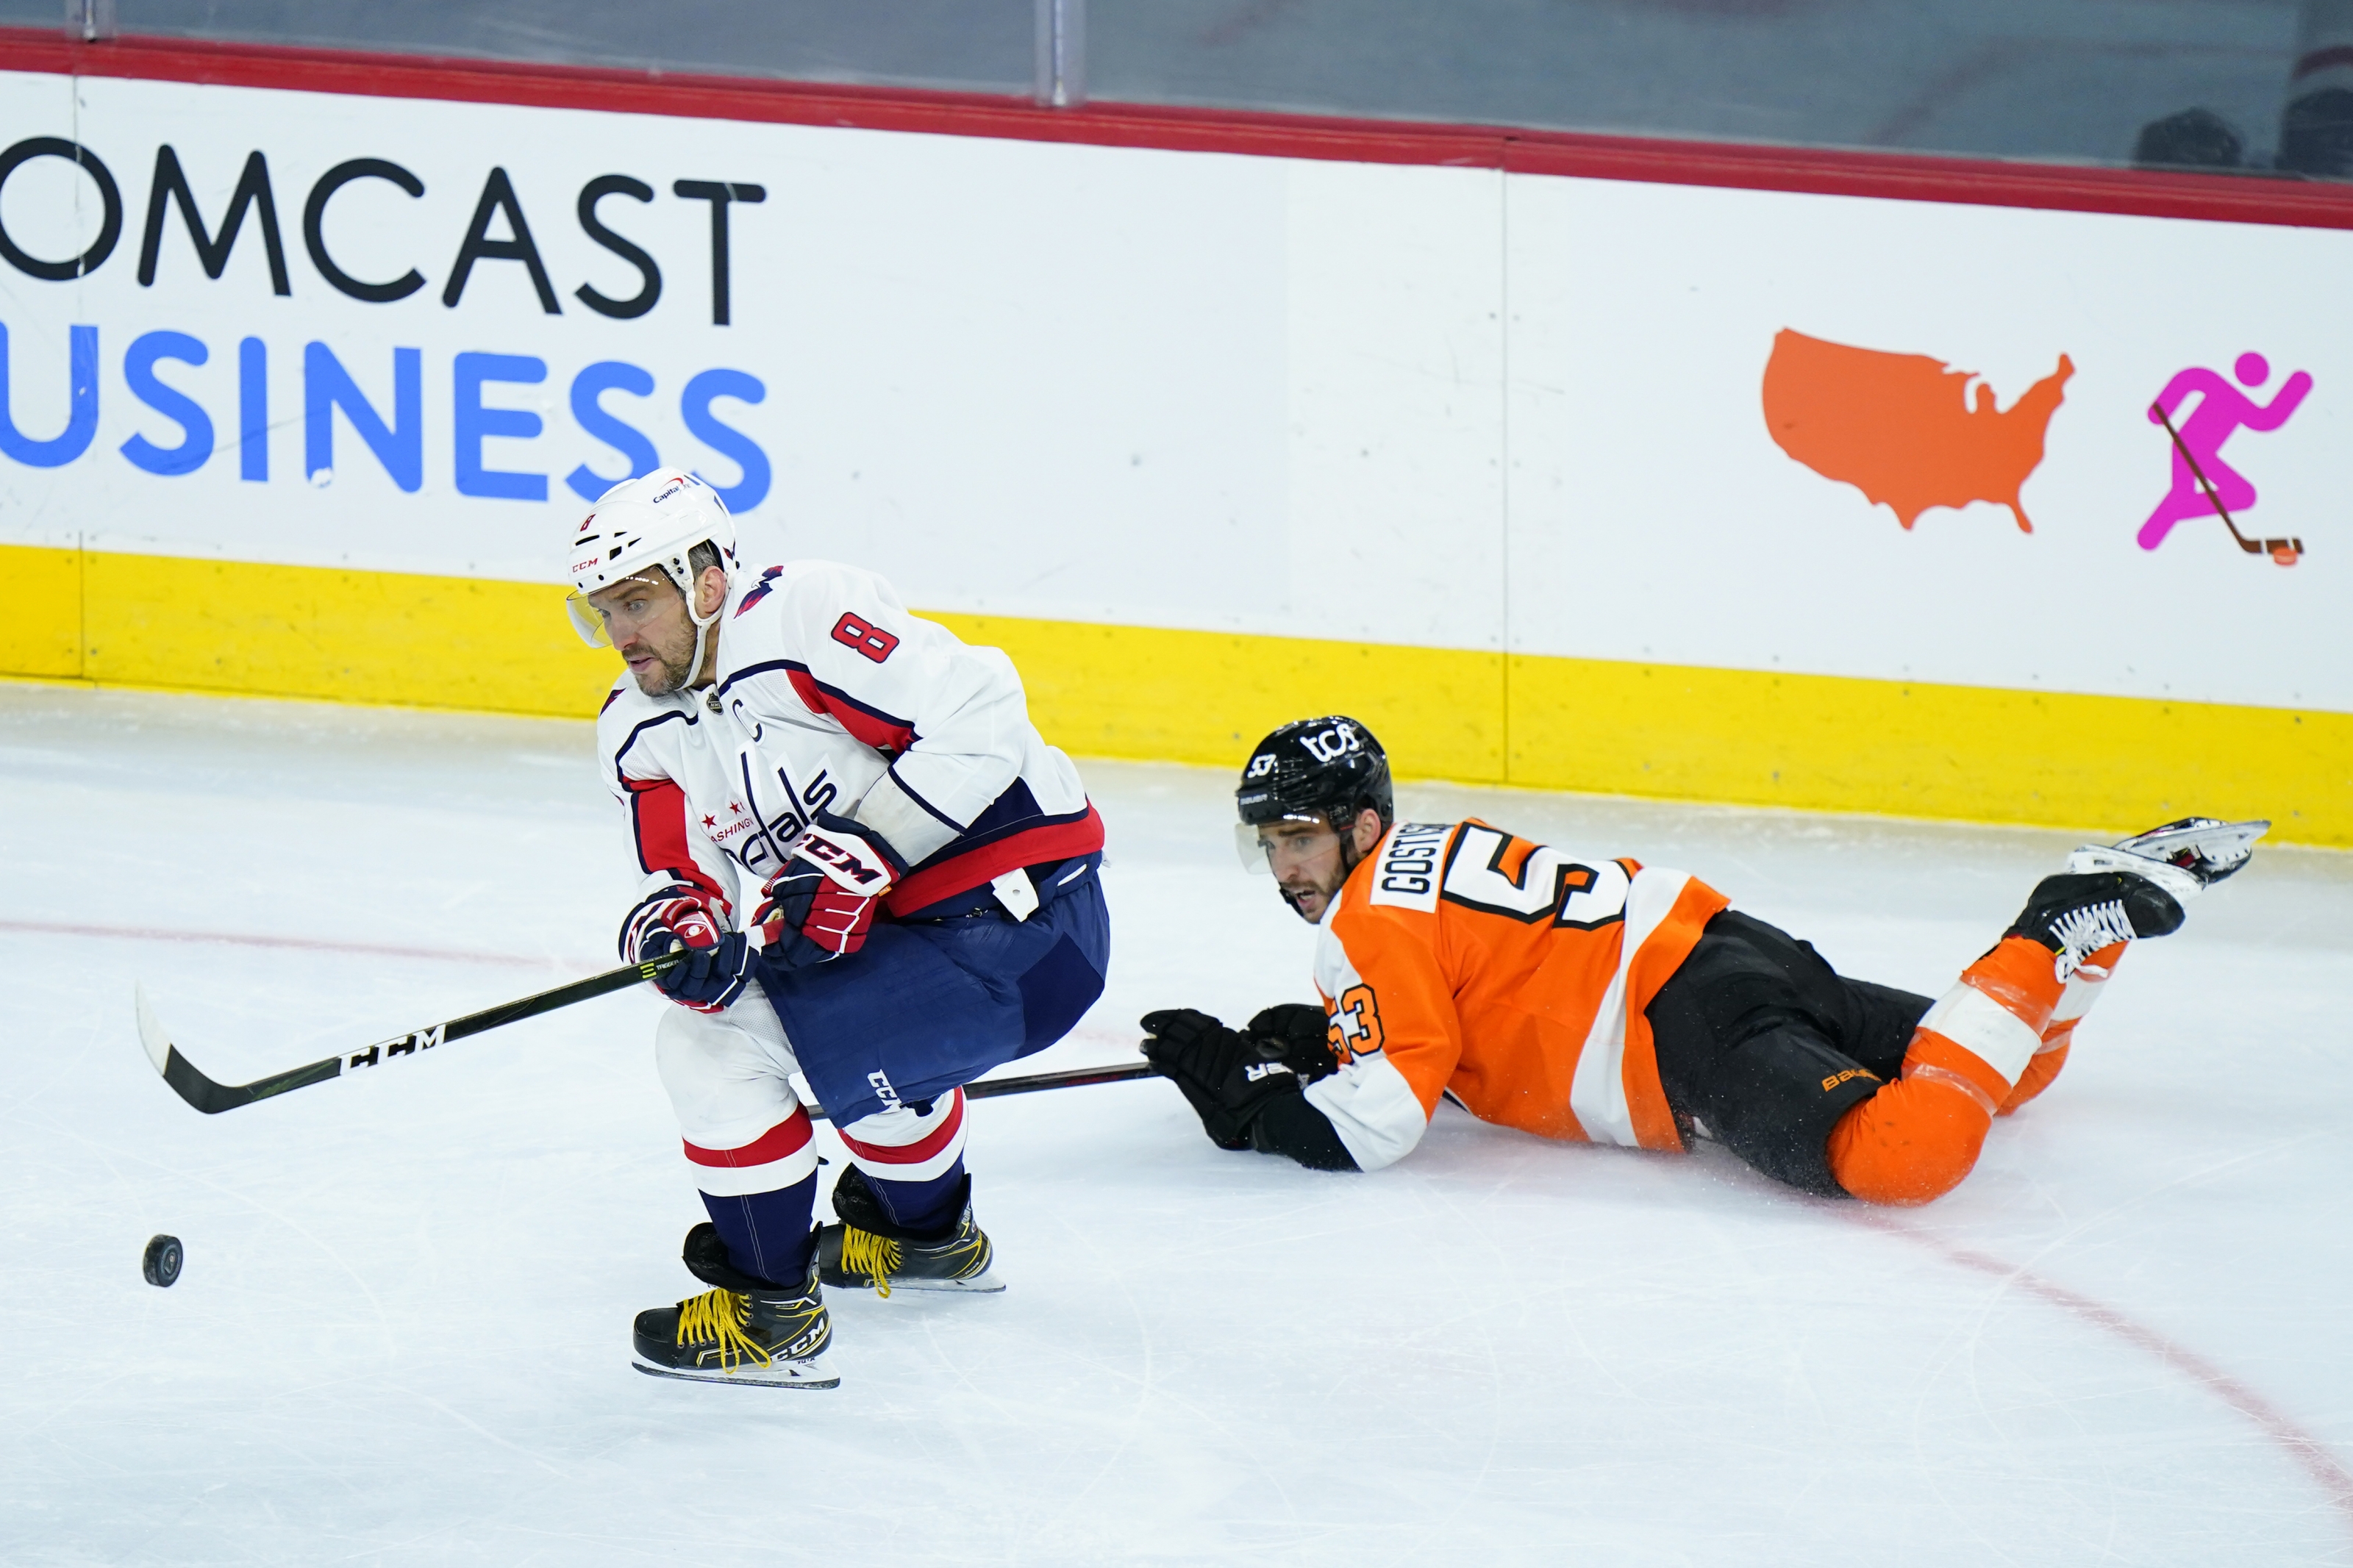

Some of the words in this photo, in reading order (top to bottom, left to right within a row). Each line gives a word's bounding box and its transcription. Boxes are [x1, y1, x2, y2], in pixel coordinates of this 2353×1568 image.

[0, 135, 766, 326] OMCAST
[0, 321, 772, 514] USINESS
[572, 557, 599, 573] CCM
[831, 611, 900, 664] 8
[732, 698, 763, 743] C
[1439, 820, 1634, 932] 53
[338, 1023, 446, 1076] CCM
[1327, 982, 1385, 1066] 53
[771, 1317, 825, 1362] CCM
